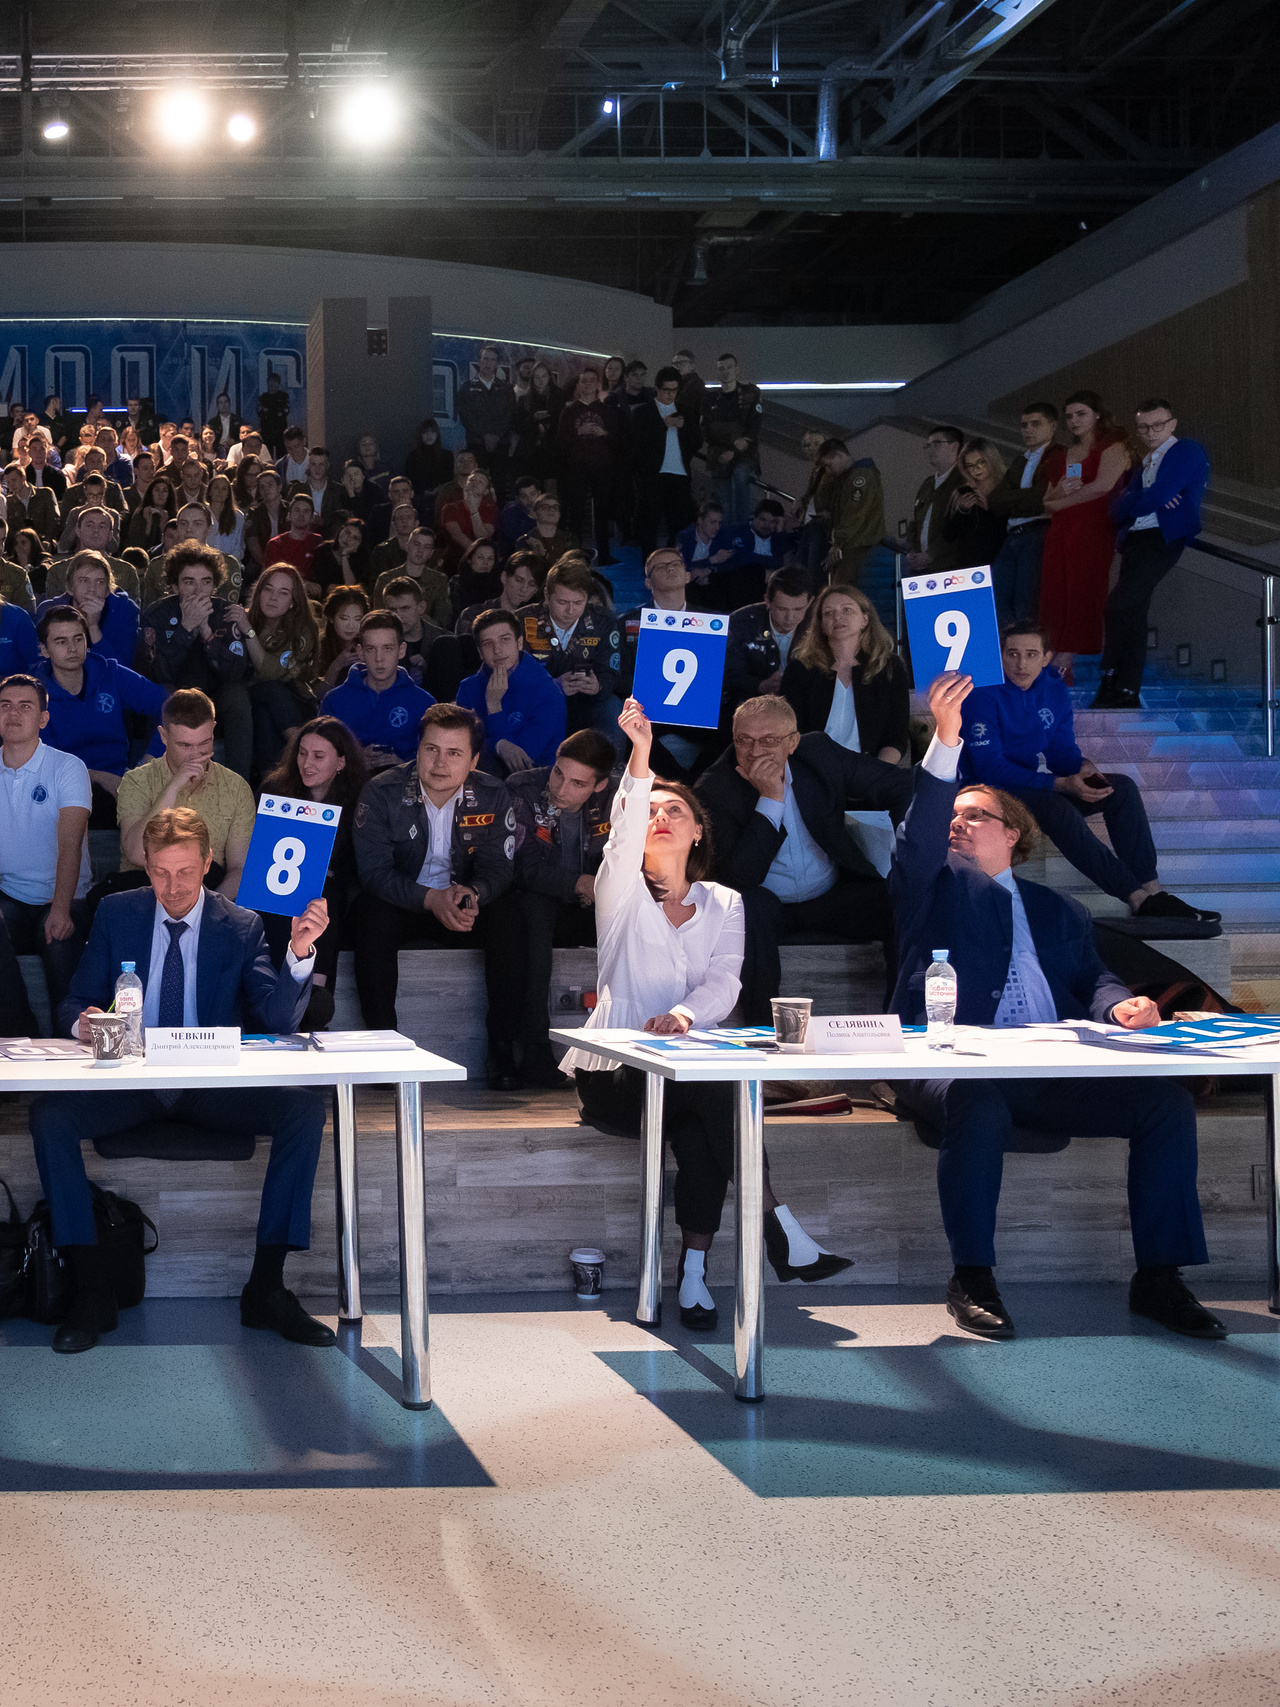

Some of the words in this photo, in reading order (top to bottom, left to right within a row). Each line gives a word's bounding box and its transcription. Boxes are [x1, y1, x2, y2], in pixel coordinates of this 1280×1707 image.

[934, 610, 971, 672] 9
[662, 648, 698, 706] 9
[266, 836, 306, 896] 8
[171, 1032, 215, 1040] ЧЕВКИН
[828, 1020, 884, 1028] СЕЛЯВИНА
[151, 1042, 182, 1050] Дмитрий
